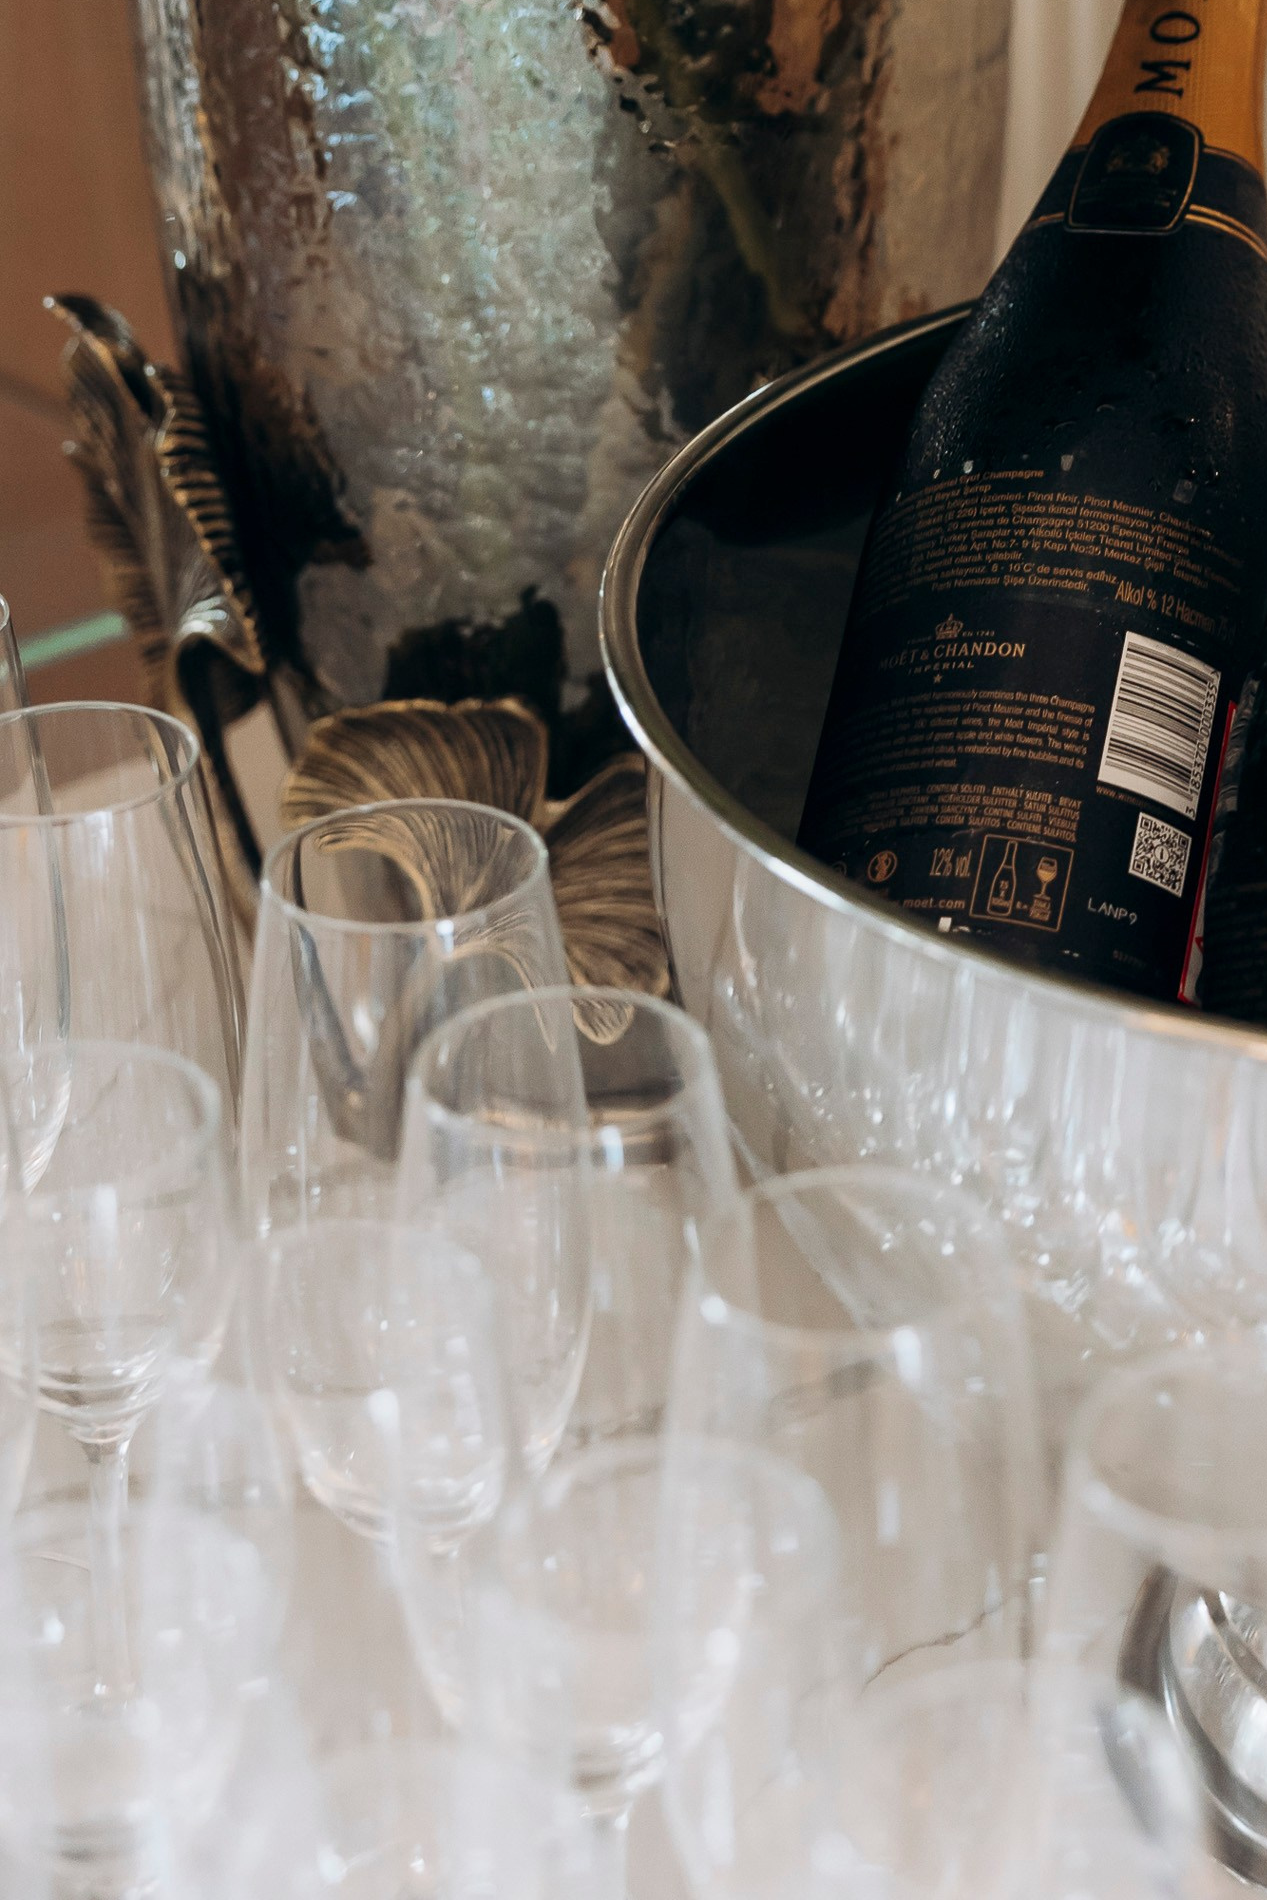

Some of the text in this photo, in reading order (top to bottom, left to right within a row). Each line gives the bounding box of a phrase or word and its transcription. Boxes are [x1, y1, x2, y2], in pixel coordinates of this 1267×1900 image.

[1027, 491, 1054, 502] Pinot
[1083, 495, 1111, 508] Pinot
[1114, 579, 1146, 607] Alkol
[1146, 587, 1159, 611] %
[1160, 592, 1177, 617] 12
[933, 640, 1027, 659] CHANDON
[929, 846, 956, 878] 12%
